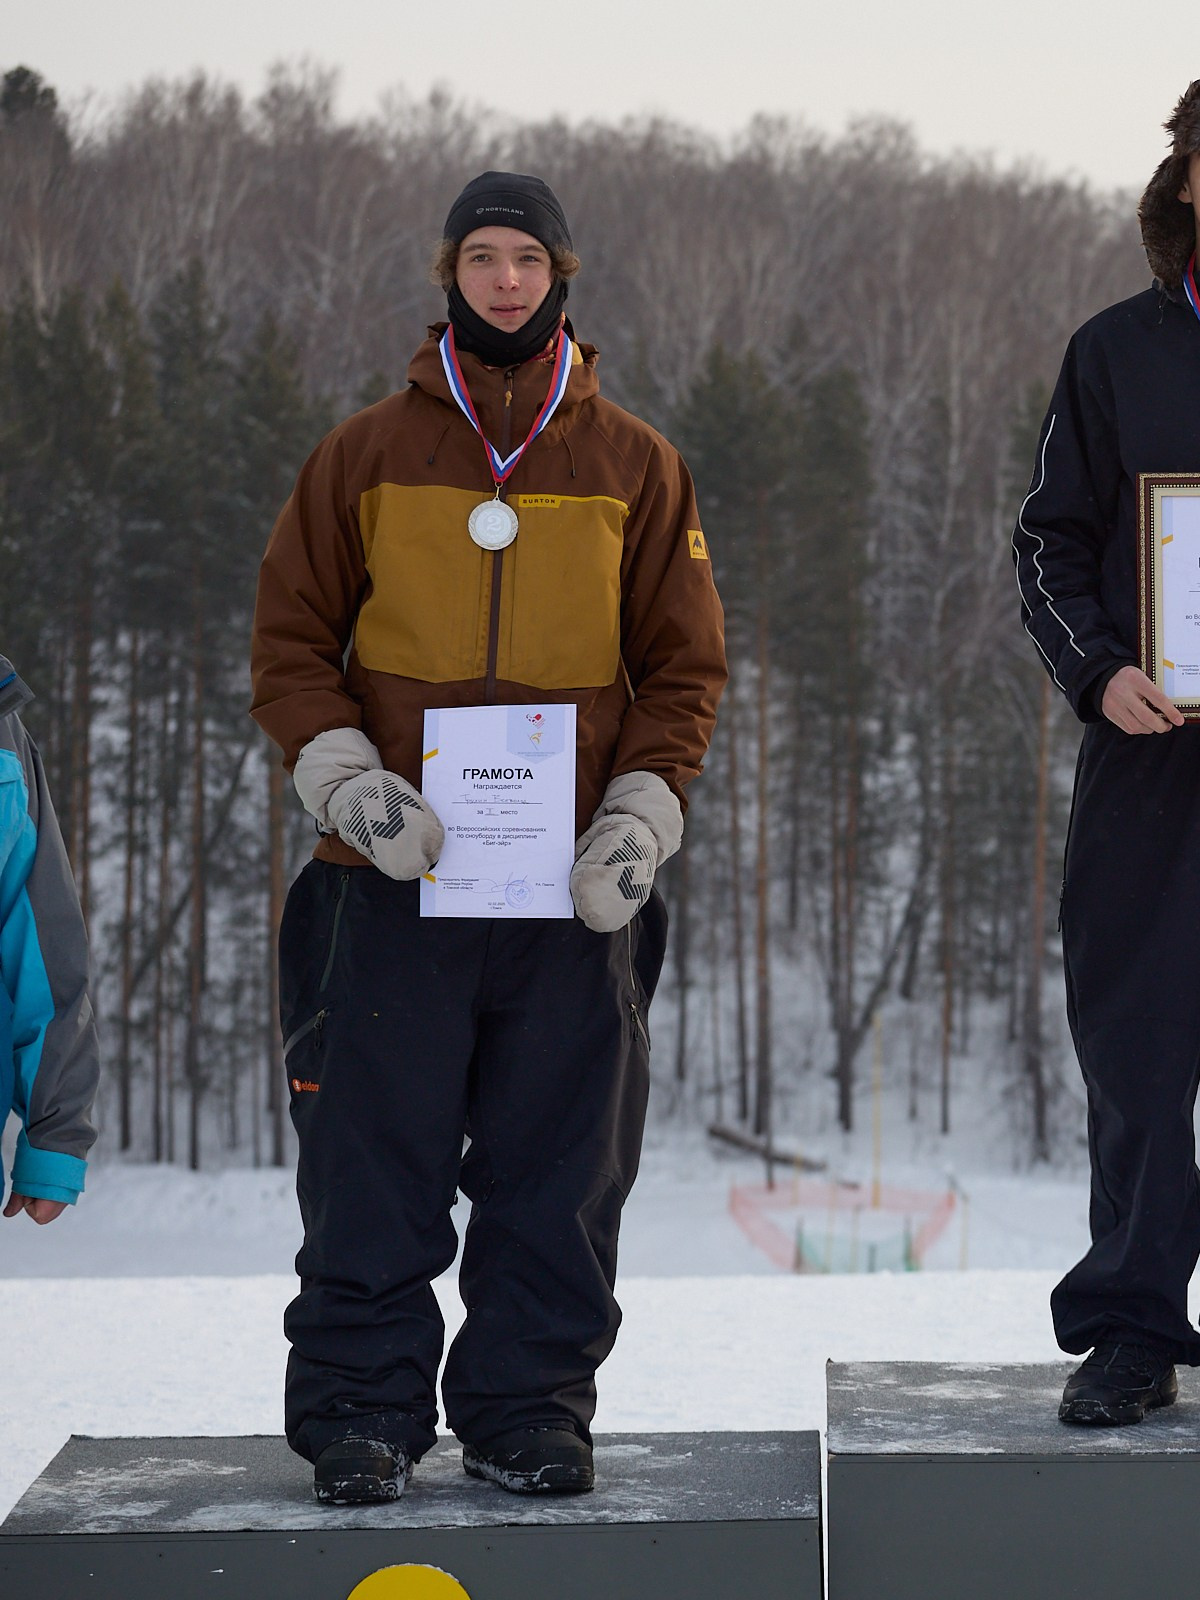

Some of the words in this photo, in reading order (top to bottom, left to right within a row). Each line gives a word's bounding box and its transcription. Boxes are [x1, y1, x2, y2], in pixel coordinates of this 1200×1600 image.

[485, 207, 525, 216] NORTHLAND
[486, 516, 501, 531] 2
[462, 768, 534, 780] ГРАМОТА
